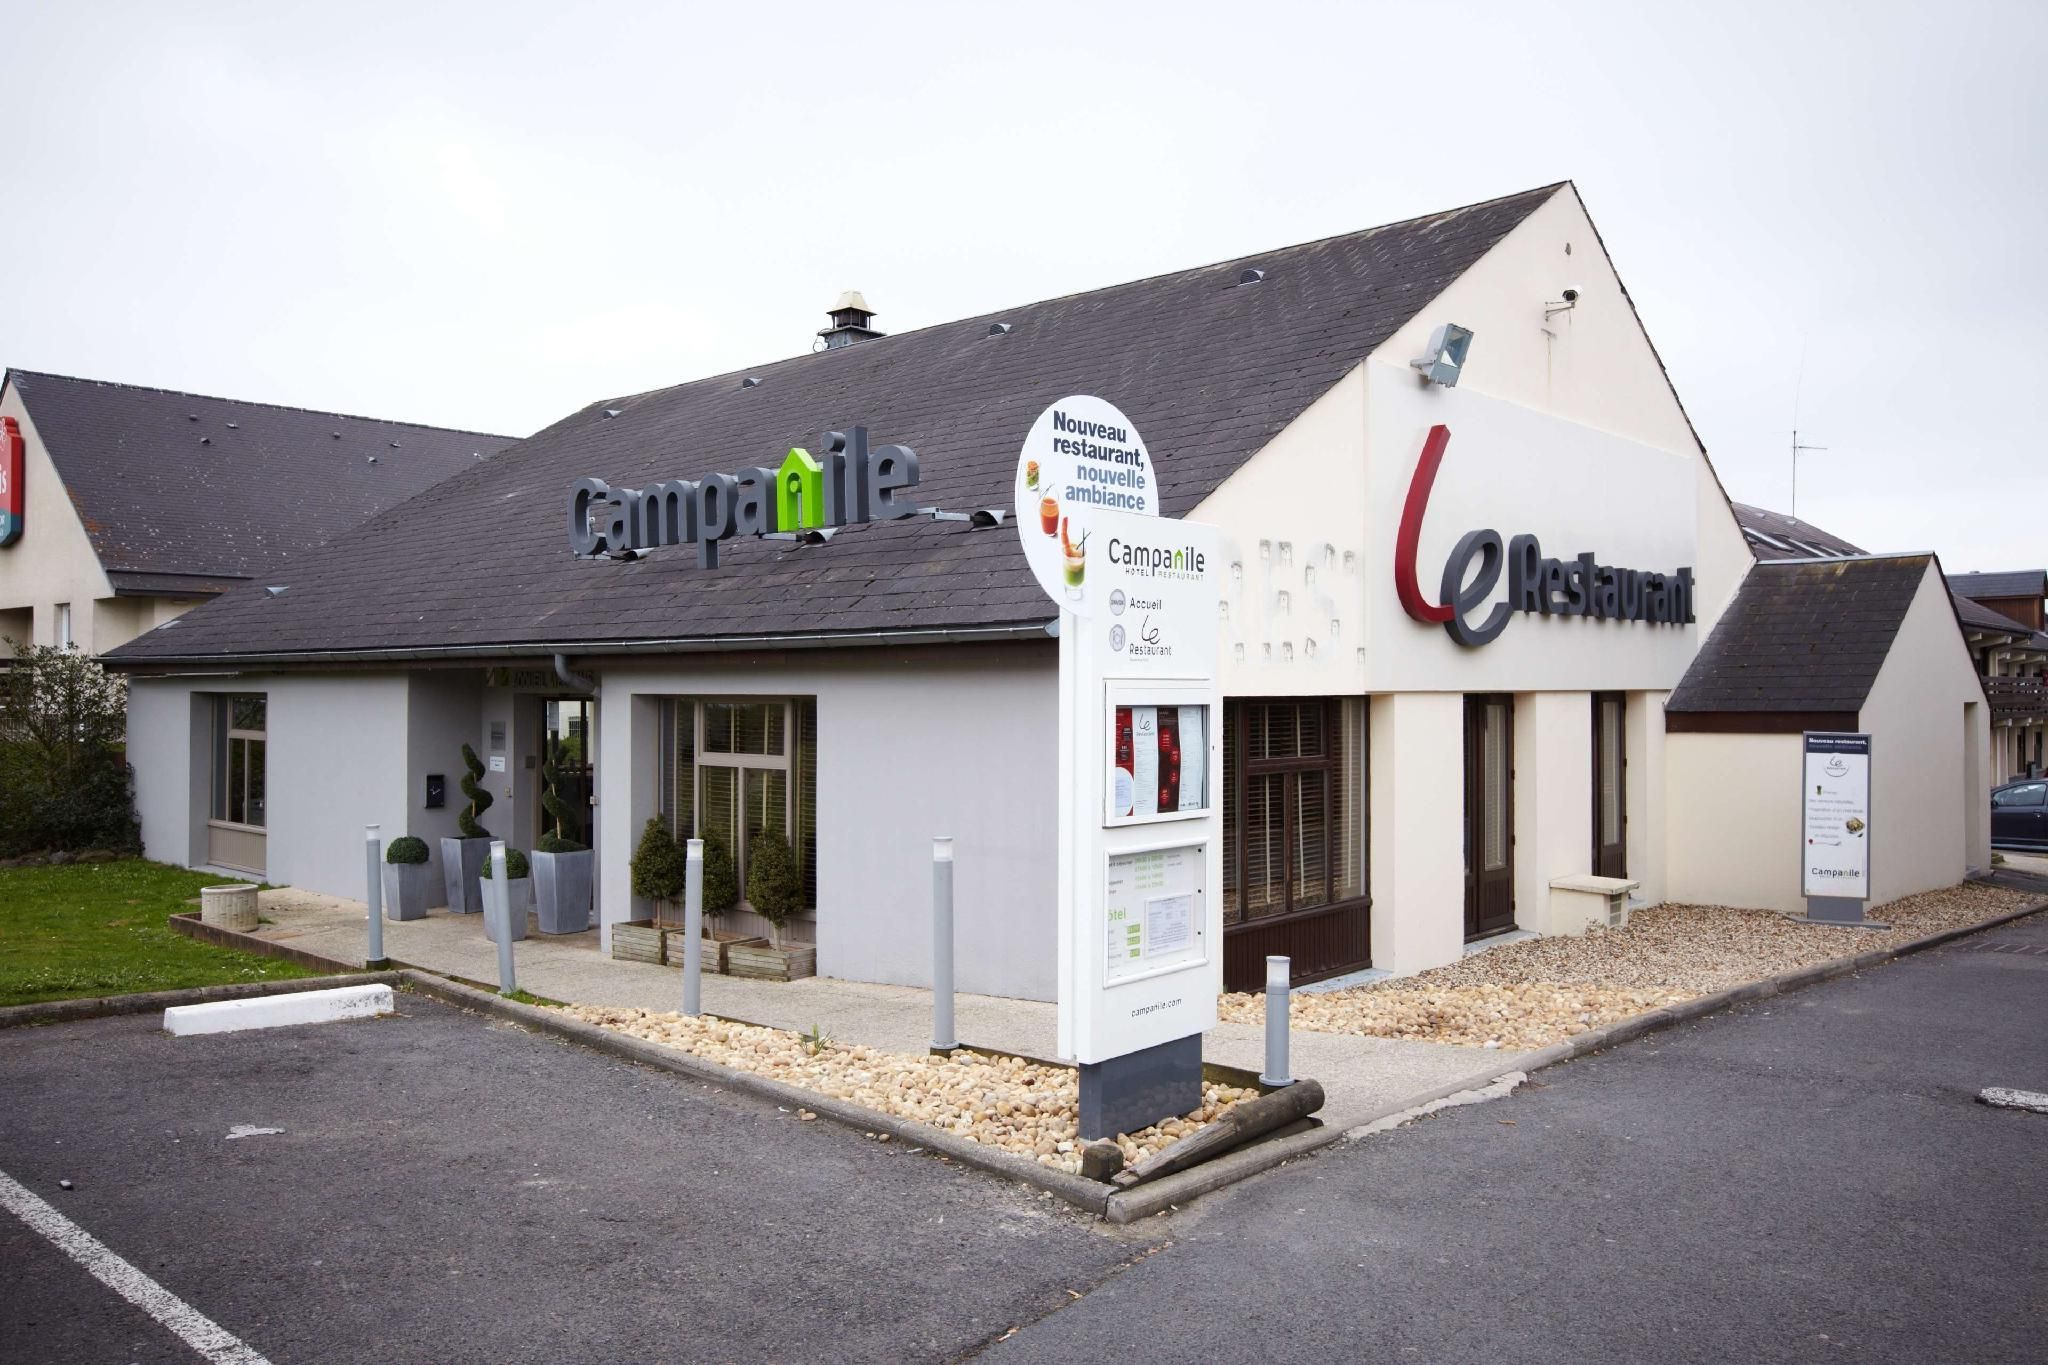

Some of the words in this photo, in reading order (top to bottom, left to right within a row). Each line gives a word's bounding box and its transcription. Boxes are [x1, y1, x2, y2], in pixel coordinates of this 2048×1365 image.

[1053, 410, 1127, 443] Nouveau
[1053, 437, 1144, 471] restaurant,
[1077, 464, 1145, 489] nouvelle
[569, 426, 920, 569] Campanile
[1065, 484, 1145, 510] ambiance
[1108, 538, 1205, 577] Campanile
[1158, 571, 1204, 582] RESTAURANT
[1508, 534, 1695, 624] Restaurant
[1129, 597, 1162, 610] Accueil
[1129, 643, 1172, 656] Restaurant
[1811, 867, 1860, 878] Campanile
[1131, 998, 1182, 1017] campanile.com
